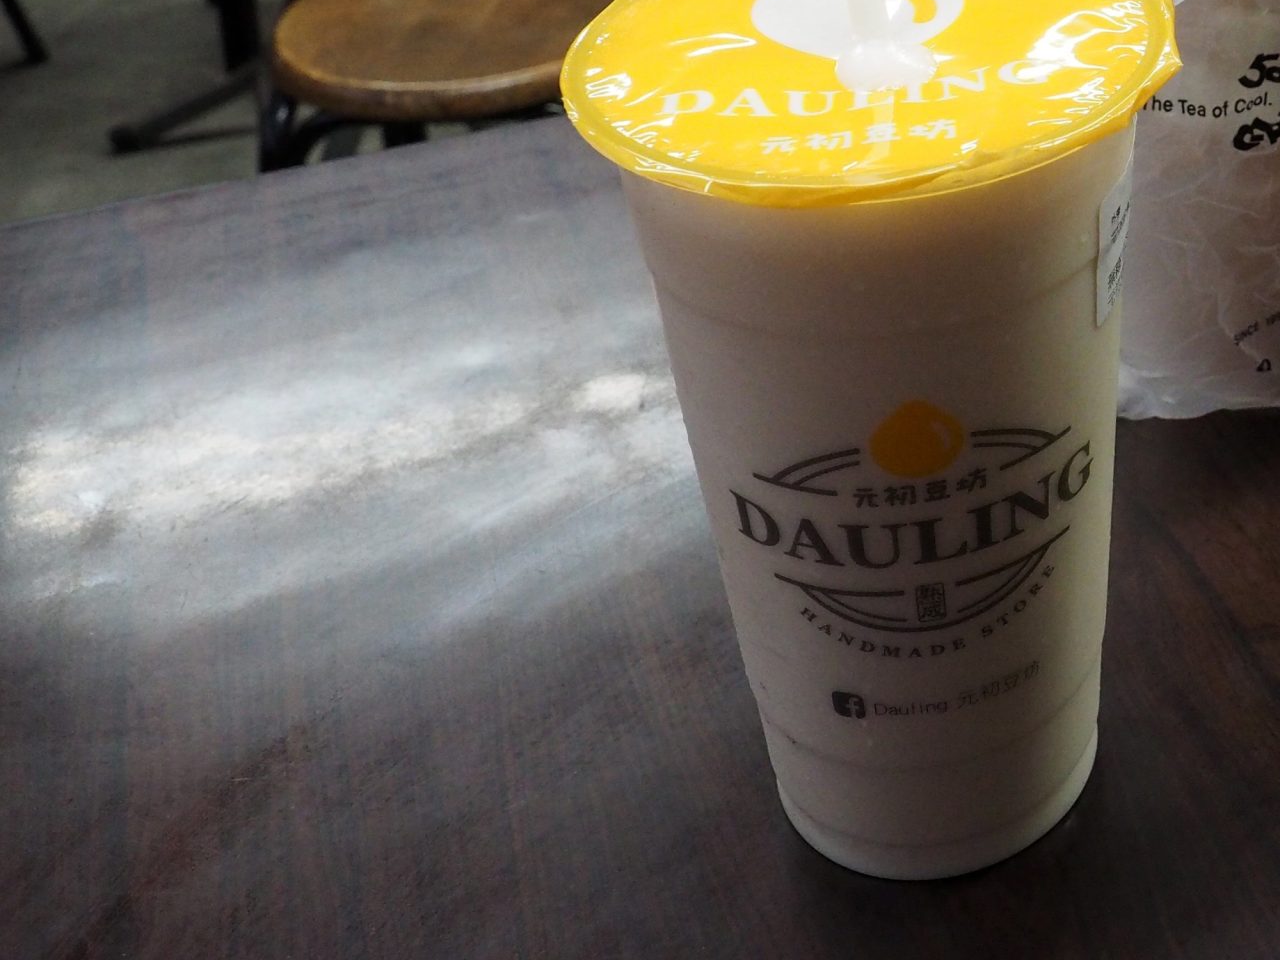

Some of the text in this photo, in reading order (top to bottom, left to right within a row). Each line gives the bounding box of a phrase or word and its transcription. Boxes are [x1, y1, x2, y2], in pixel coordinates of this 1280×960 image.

[1178, 99, 1206, 117] Tea
[1212, 101, 1228, 118] of
[729, 440, 1093, 569] DAULING
[853, 468, 988, 509] 元初豆坊
[800, 563, 1056, 659] HANDMADE STORE
